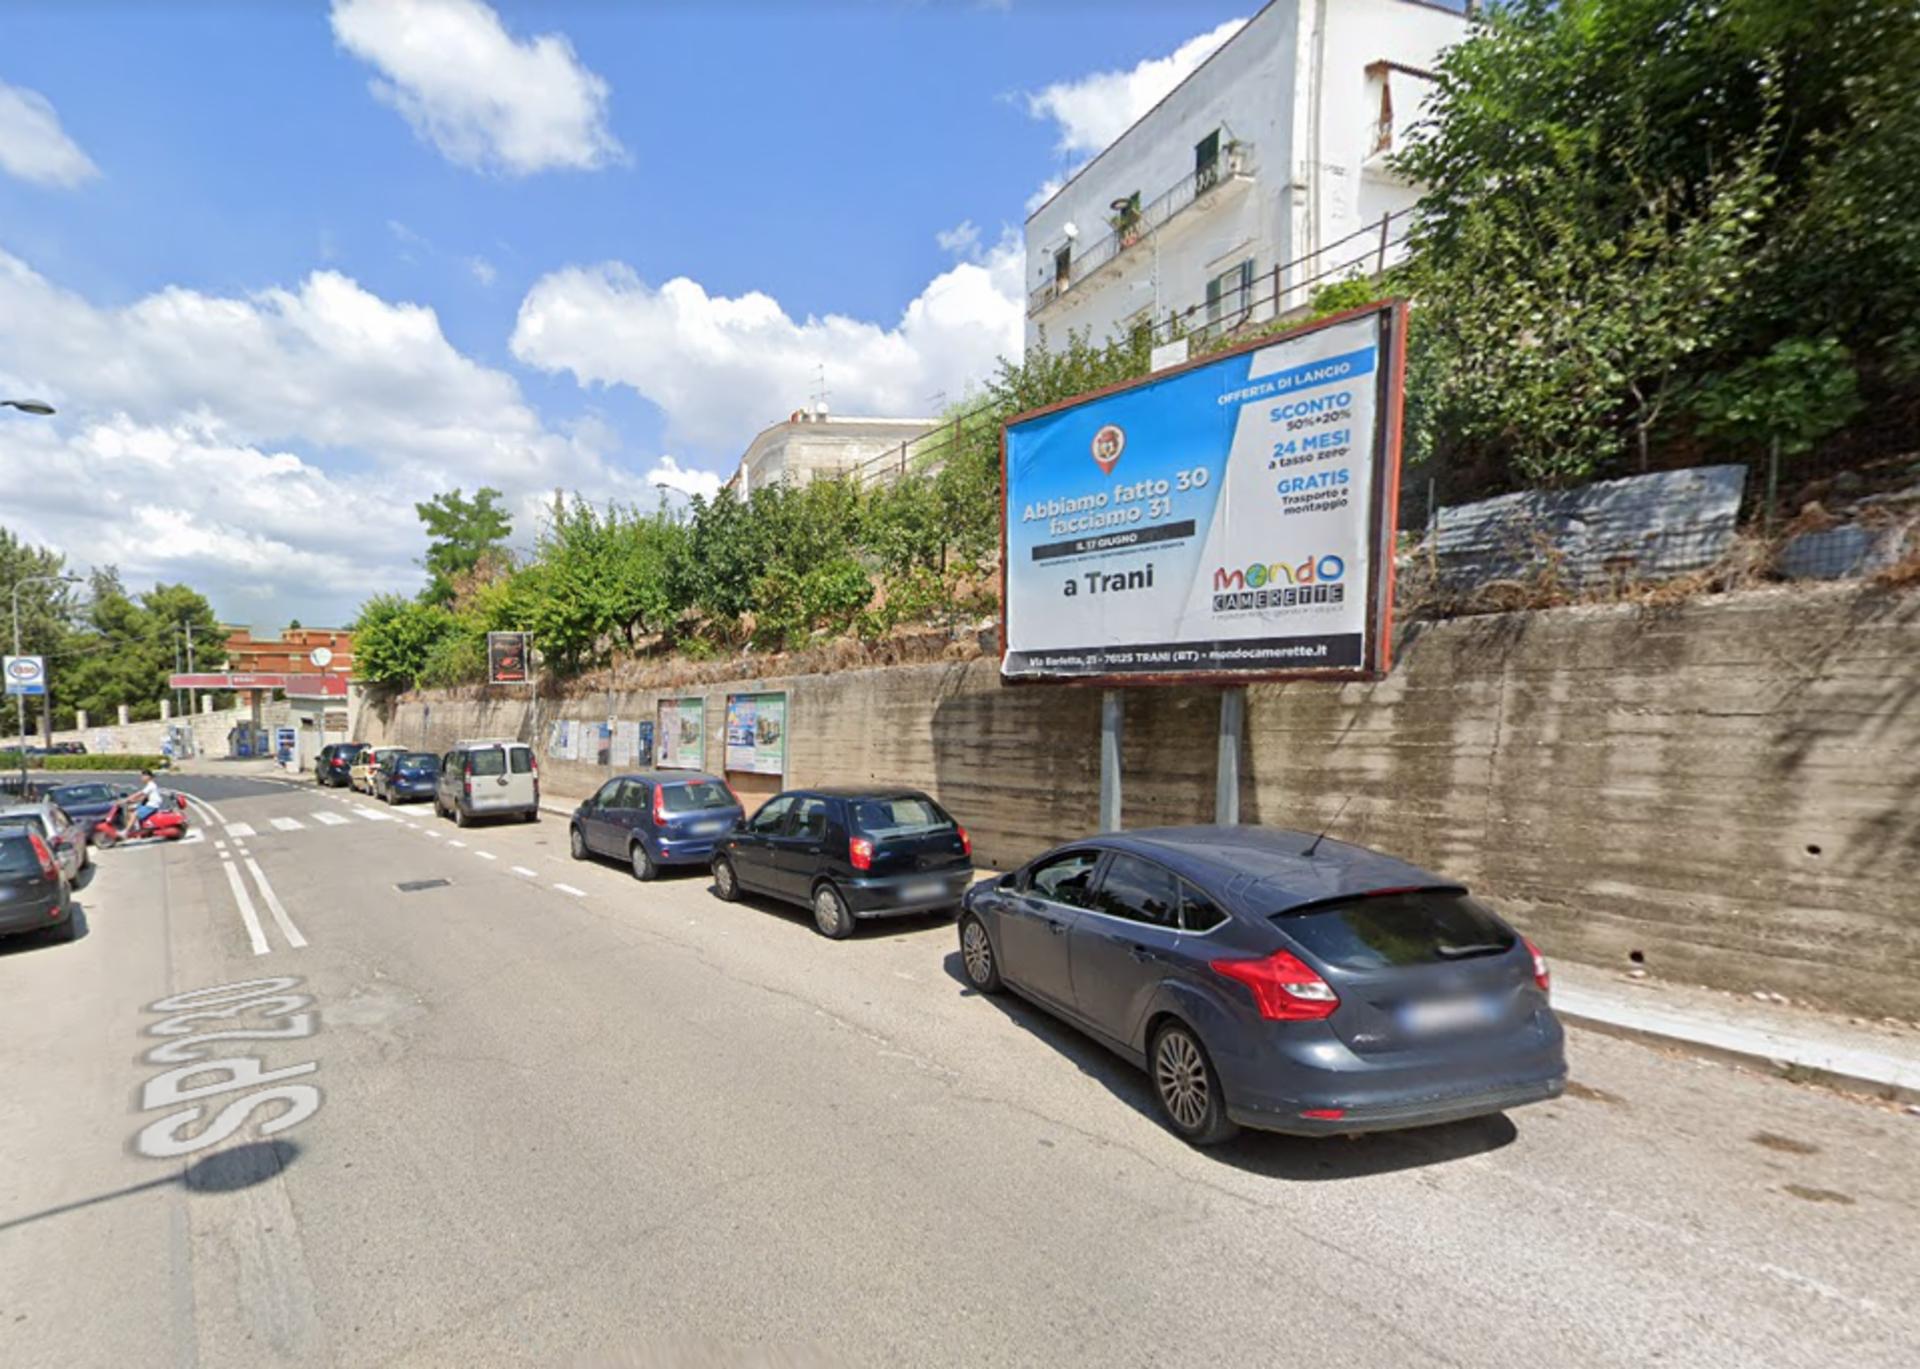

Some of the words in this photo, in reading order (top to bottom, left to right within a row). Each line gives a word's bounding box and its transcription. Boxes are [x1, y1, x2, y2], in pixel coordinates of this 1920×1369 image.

[1218, 383, 1275, 406] OFFERTA
[1277, 377, 1292, 390] DI
[1295, 362, 1351, 385] LANCIO
[1270, 391, 1353, 423] SCONTO
[1273, 440, 1297, 458] 24
[1302, 429, 1350, 452] MESI
[1268, 460, 1276, 470] a
[1280, 453, 1314, 468] tasso
[1023, 492, 1108, 523] Abbiamo
[1114, 478, 1170, 504] fatto
[1176, 467, 1210, 492] 30
[1277, 468, 1350, 494] GRATIS
[1282, 489, 1339, 506] Trasporto
[1341, 487, 1349, 497] e
[1284, 498, 1349, 516] montaggio
[1049, 506, 1143, 536] facciamo
[1148, 496, 1173, 519] 31
[1097, 532, 1138, 547] GIUGNO
[1063, 578, 1078, 597] a
[1084, 563, 1154, 594] Trani
[1212, 583, 1345, 612] CAMERETTE
[1136, 651, 1171, 663] TRANI
[1209, 644, 1328, 660] mondocamerette.it
